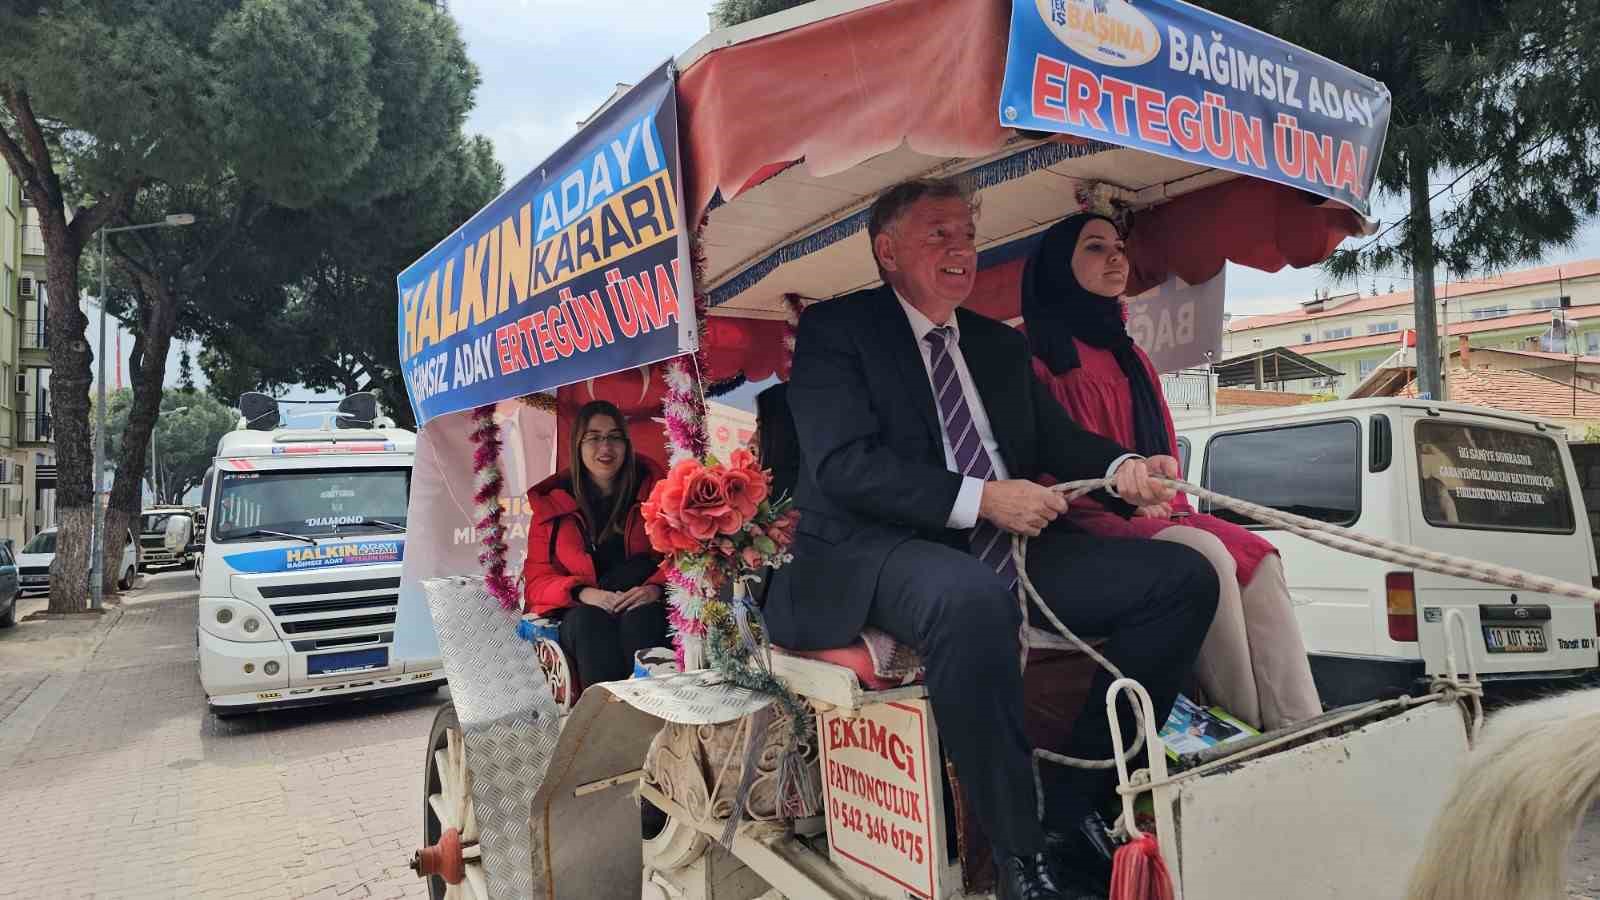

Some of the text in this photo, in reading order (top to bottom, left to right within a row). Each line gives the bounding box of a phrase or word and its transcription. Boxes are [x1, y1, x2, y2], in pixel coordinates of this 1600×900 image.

[1031, 53, 1267, 169] ERTEGÜN
[1167, 25, 1373, 128] BAĞIMSIZ ADAY
[401, 115, 660, 363] HALKIN ADAYI
[532, 176, 677, 286] KARARI
[452, 333, 494, 389] ADAY
[496, 286, 615, 375] ERTEGÜN
[287, 544, 358, 561] HALKIN
[306, 516, 363, 527] DIAMOND
[829, 759, 922, 823] FAYTONCULUK
[832, 798, 923, 864] 0 542 346 6175
